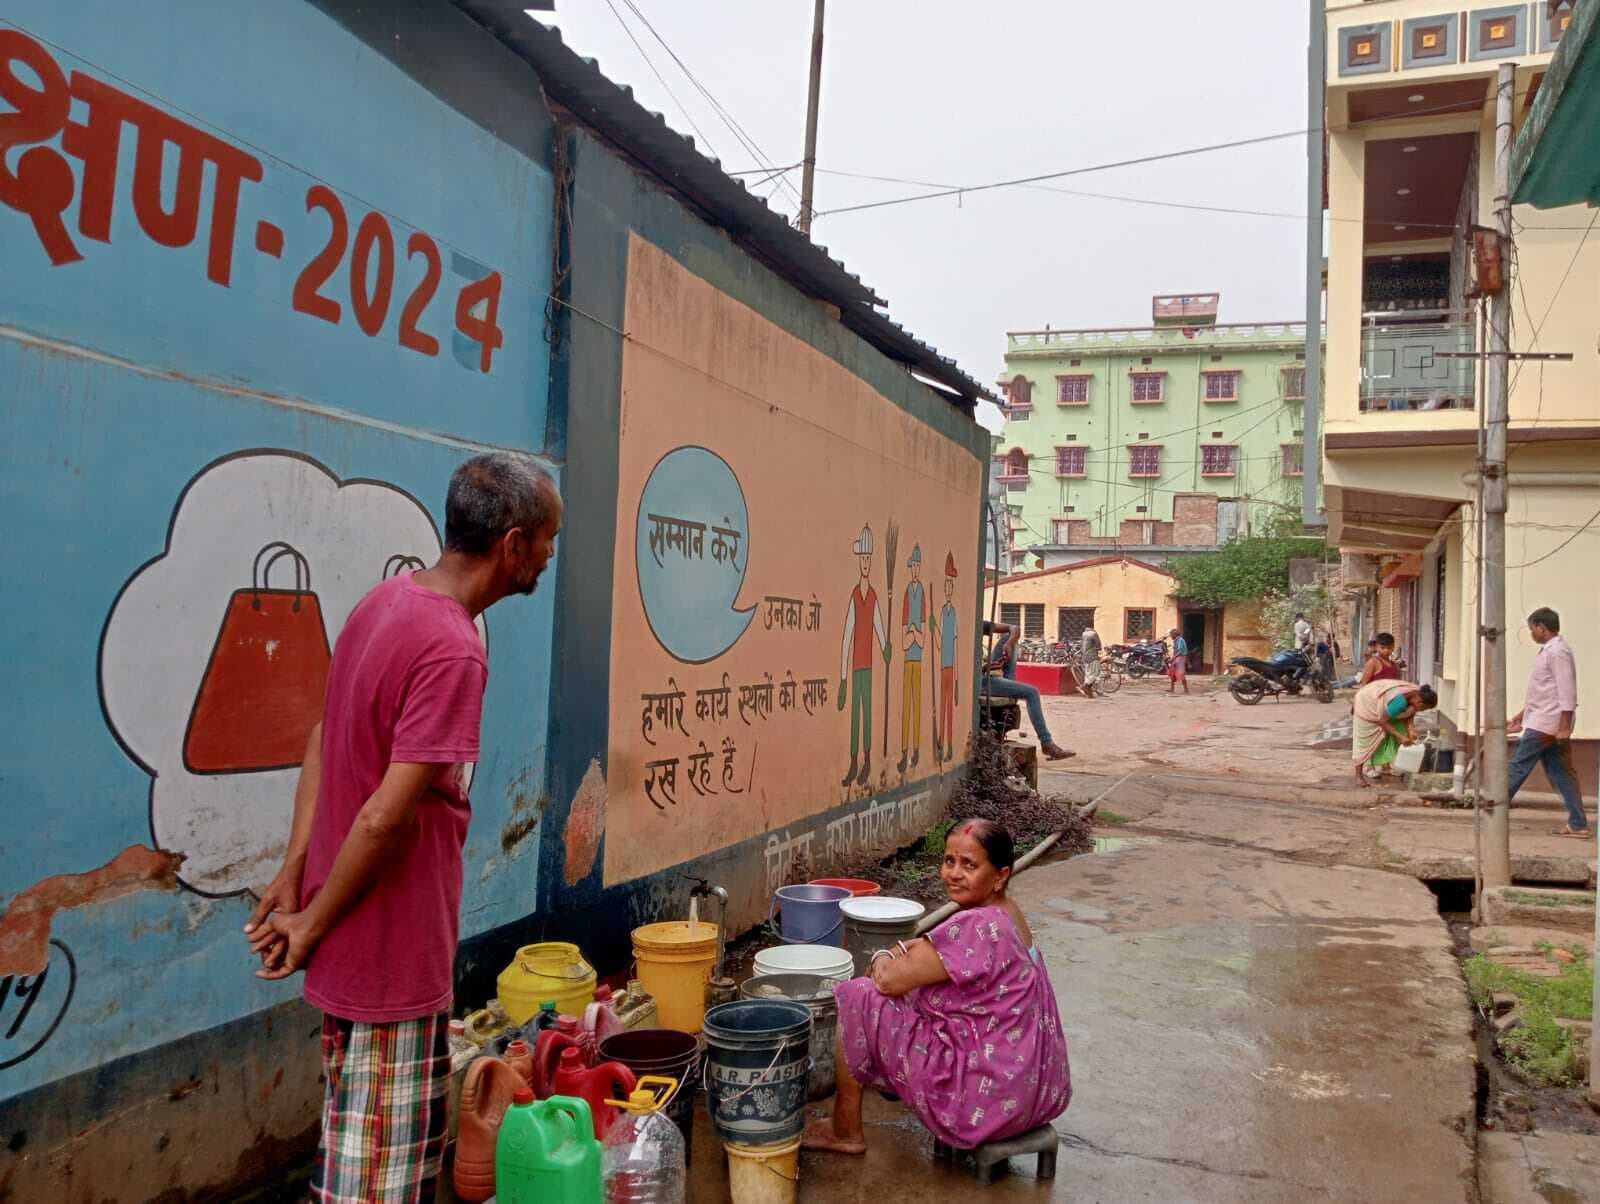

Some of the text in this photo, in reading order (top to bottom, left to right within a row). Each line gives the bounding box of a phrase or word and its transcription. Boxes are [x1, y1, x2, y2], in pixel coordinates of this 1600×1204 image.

[647, 512, 707, 568] सम्मान
[763, 593, 822, 632] उनका जो
[641, 669, 828, 745] हमारे कार्य स्थलों को साफ
[644, 757, 680, 810] रख
[687, 740, 719, 796] रहे
